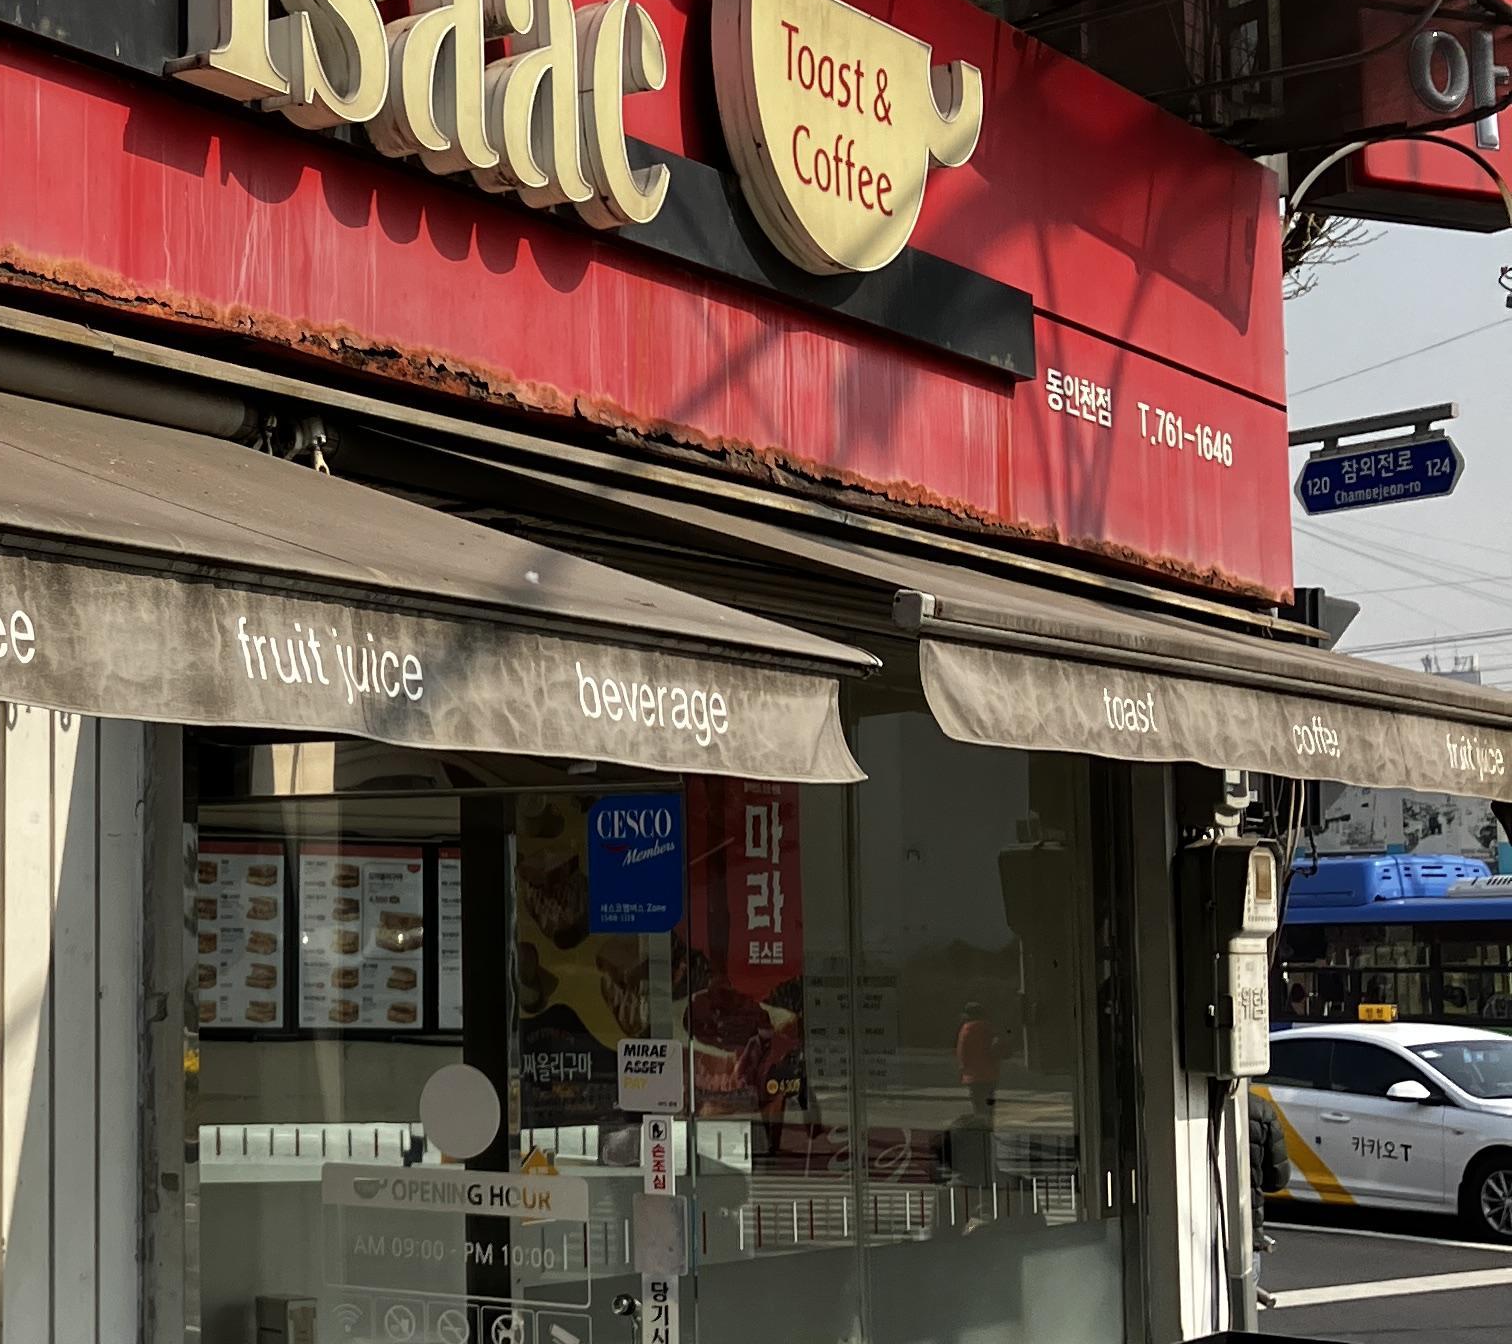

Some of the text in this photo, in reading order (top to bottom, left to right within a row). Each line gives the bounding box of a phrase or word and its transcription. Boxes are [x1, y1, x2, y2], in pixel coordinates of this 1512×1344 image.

[780, 19, 894, 127] Toast &
[791, 125, 894, 218] Coffee
[1045, 368, 1113, 428] 동인천점
[1137, 401, 1233, 468] T.761-1646
[1341, 450, 1414, 485] 참외전로
[1425, 457, 1451, 477] 124
[1307, 476, 1331, 496] 120
[1334, 481, 1422, 506] Chamoejeon-ro
[237, 616, 424, 704] fruit juice
[575, 661, 729, 747] beverage
[1103, 687, 1159, 734] toast
[596, 808, 672, 840] CESCO
[622, 839, 676, 868] Members
[744, 800, 785, 934] 마라
[748, 941, 784, 965] 토스트
[623, 1044, 668, 1058] MIRAE
[623, 1060, 665, 1075] ASSET
[651, 1143, 668, 1190] 손조심
[390, 1179, 552, 1211] OPENING HOUR
[353, 1235, 385, 1256] AM
[391, 1236, 445, 1262] 09:00
[463, 1240, 494, 1266] PM
[500, 1242, 556, 1269] 10:00
